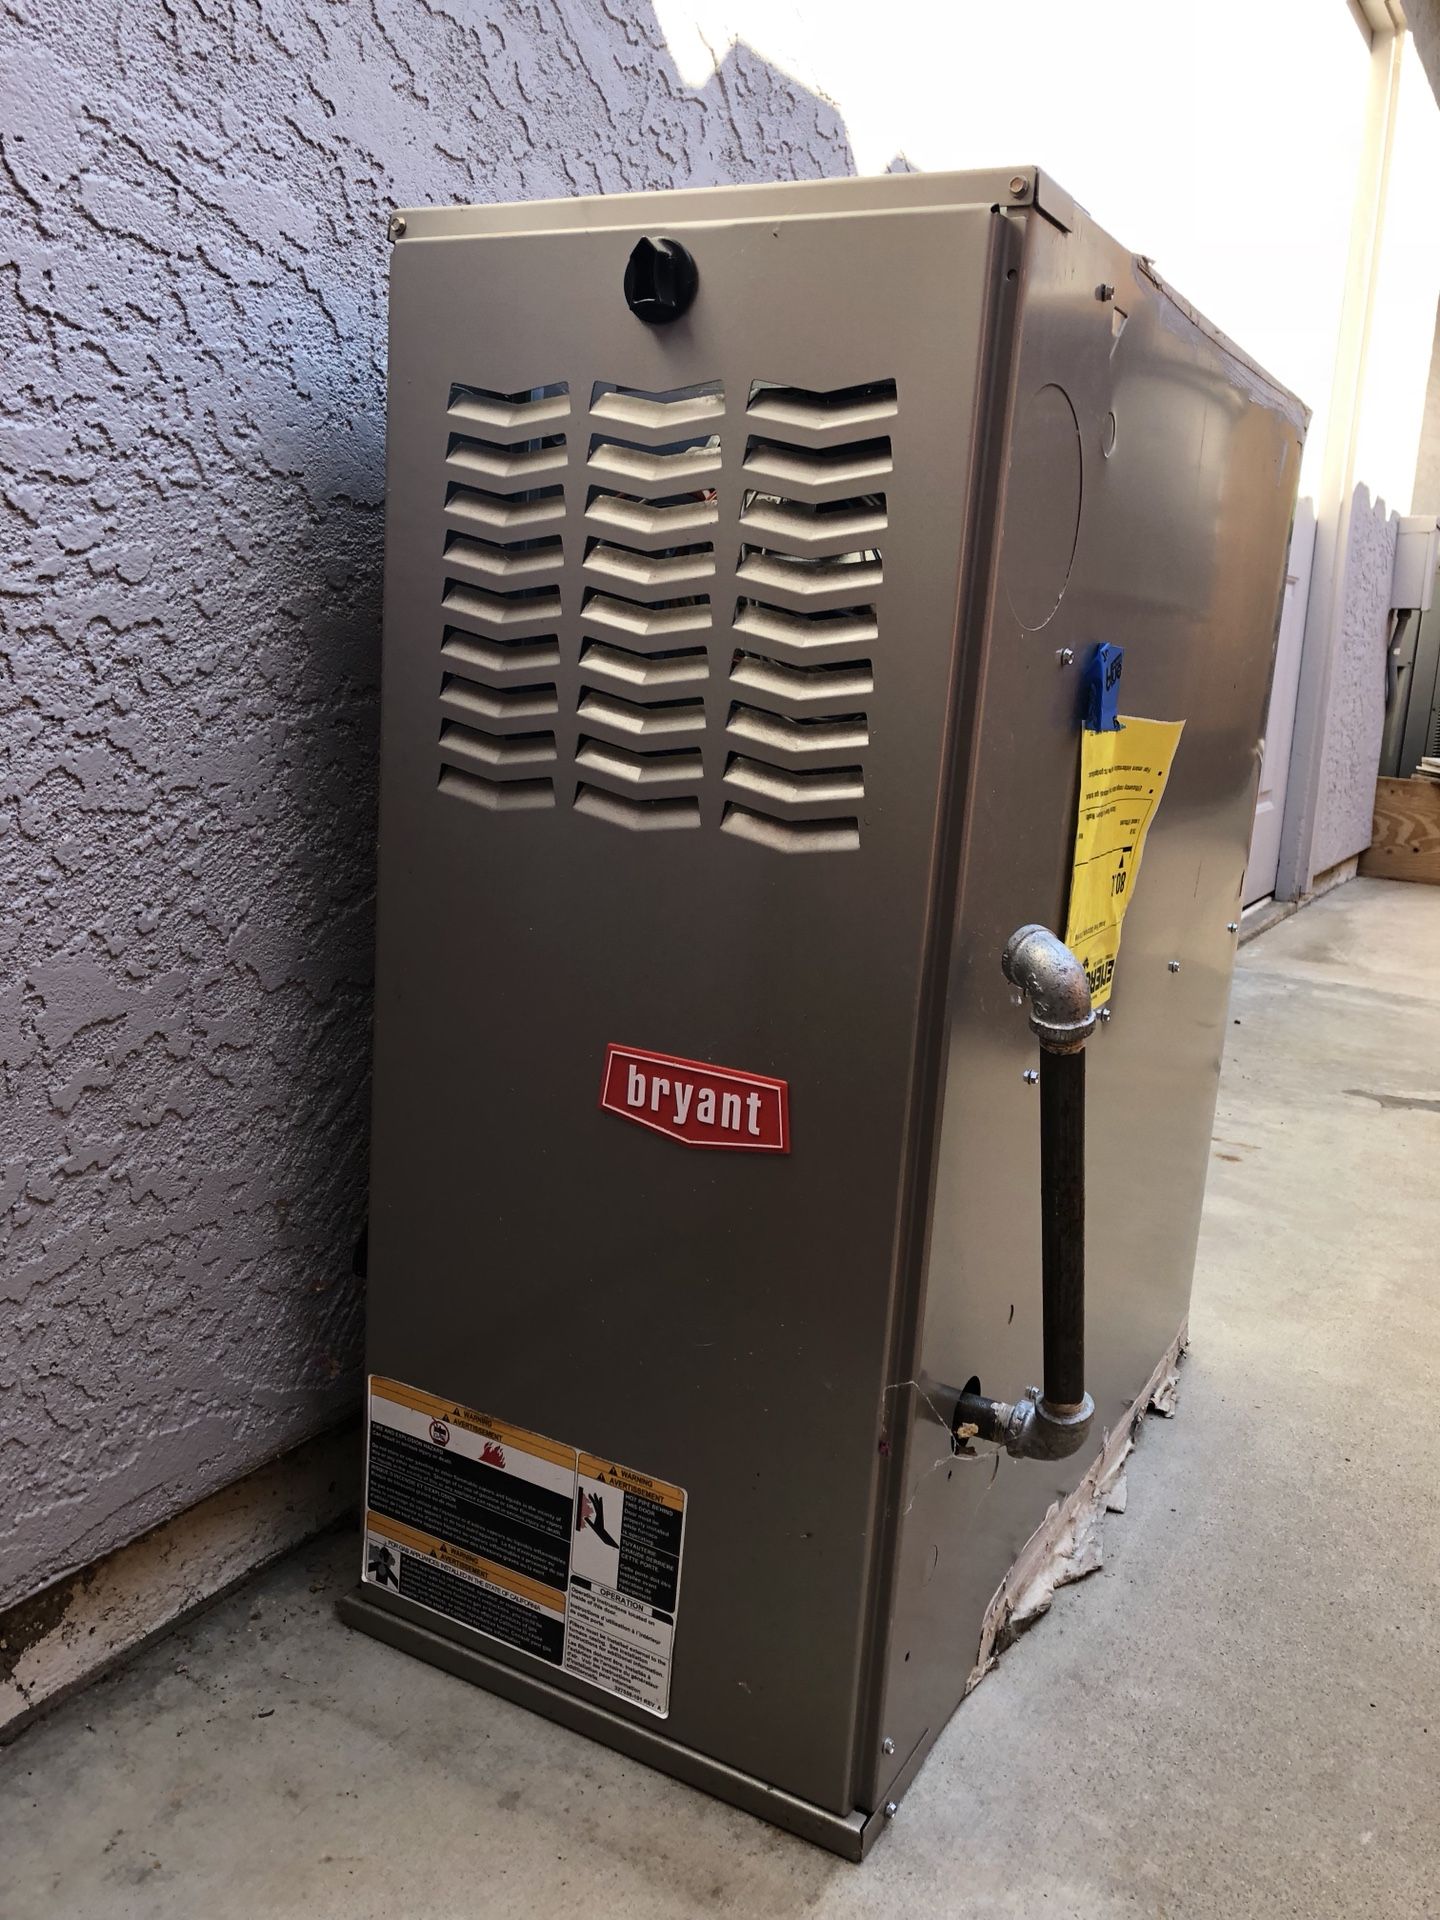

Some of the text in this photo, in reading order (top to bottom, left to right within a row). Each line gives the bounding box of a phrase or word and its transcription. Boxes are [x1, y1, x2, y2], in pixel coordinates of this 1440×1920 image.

[627, 1064, 763, 1136] bryant
[454, 1418, 502, 1443] AVERTISSEMENT
[464, 1411, 492, 1428] WARNING
[609, 1477, 664, 1504] AVERTISSEMENT
[621, 1469, 653, 1488] WARNING
[625, 1494, 637, 1503] HOT
[441, 1553, 488, 1579] AVERTISSEMENT
[451, 1547, 478, 1565] WARNING
[388, 1540, 398, 1549] FOR
[410, 1550, 440, 1567] APPLIANCES
[441, 1563, 467, 1579] INSTALLED
[475, 1578, 484, 1587] THE
[486, 1582, 501, 1594] STATE
[502, 1589, 509, 1597] OF
[510, 1593, 541, 1611] CALIFORNIA
[572, 1587, 596, 1602] Operating
[600, 1588, 644, 1612] OPERATION
